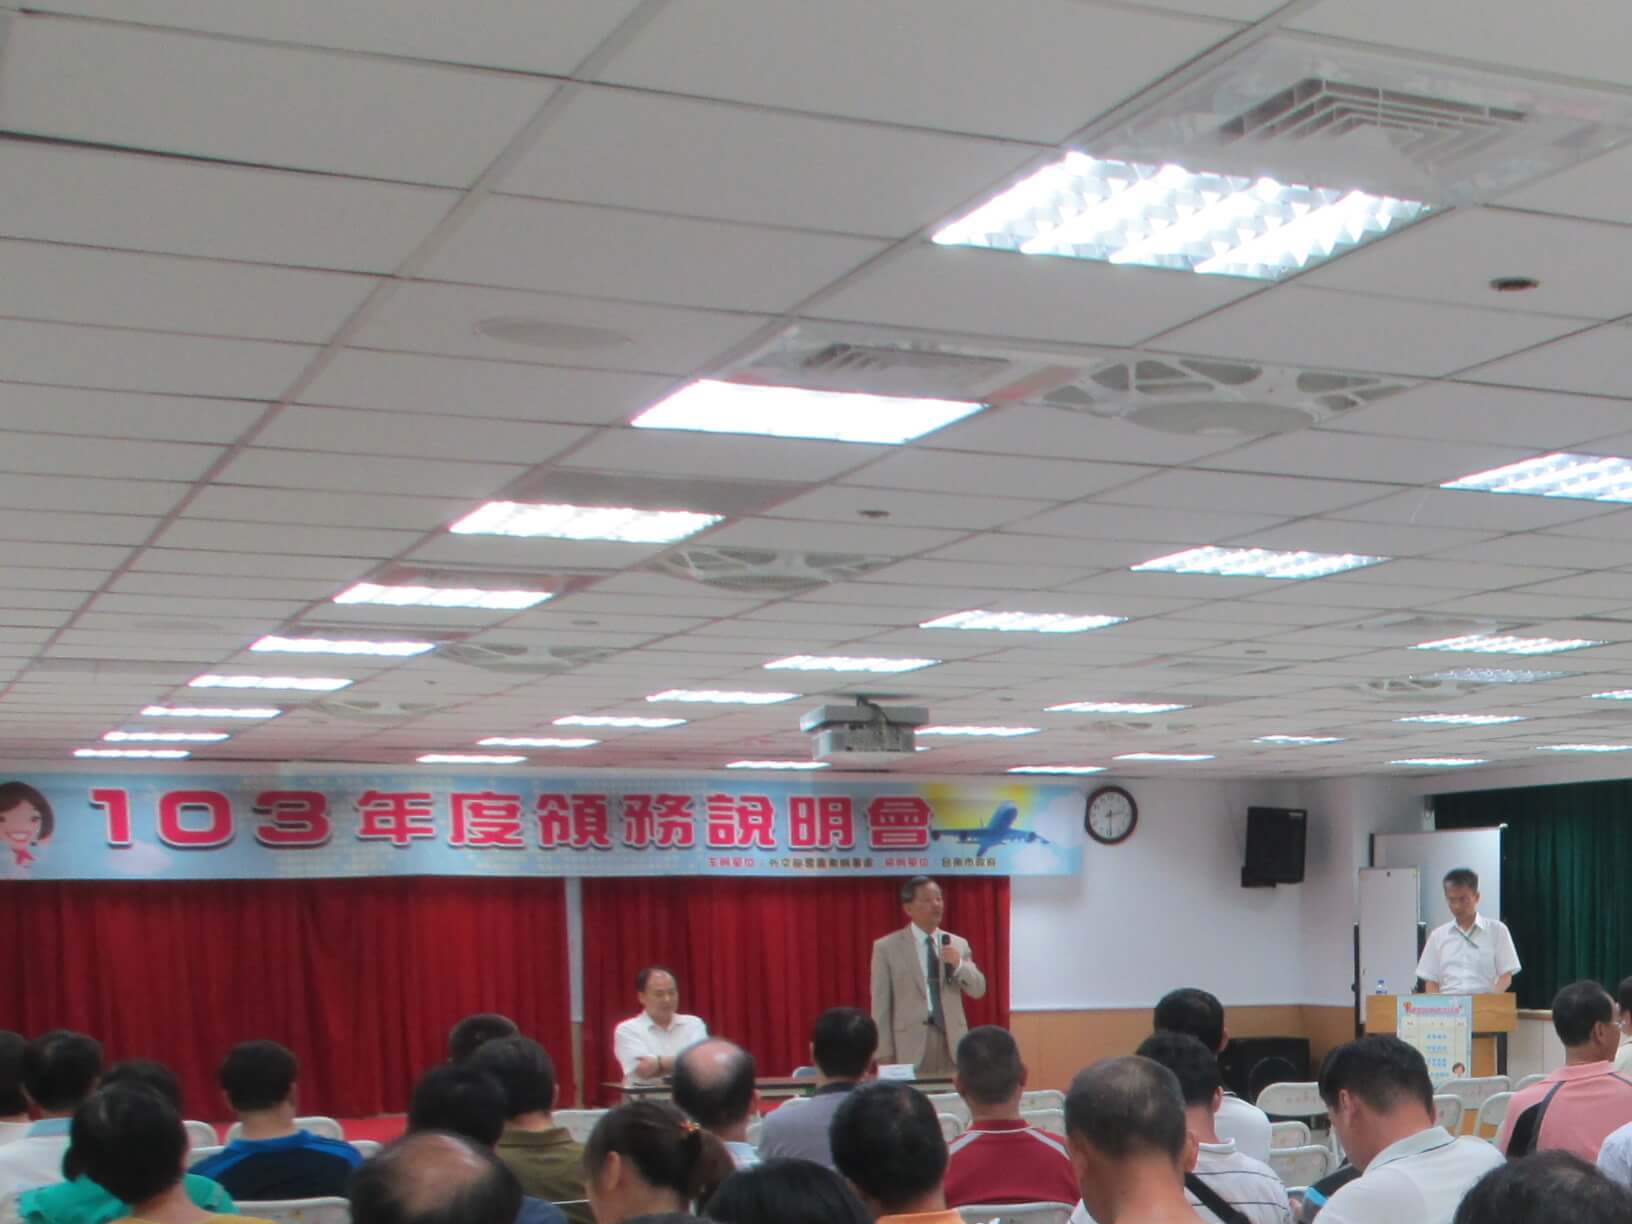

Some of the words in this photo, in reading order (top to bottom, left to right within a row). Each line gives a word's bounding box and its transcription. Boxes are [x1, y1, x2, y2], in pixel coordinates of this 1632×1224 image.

[90, 787, 934, 850] 103年度領務說明會
